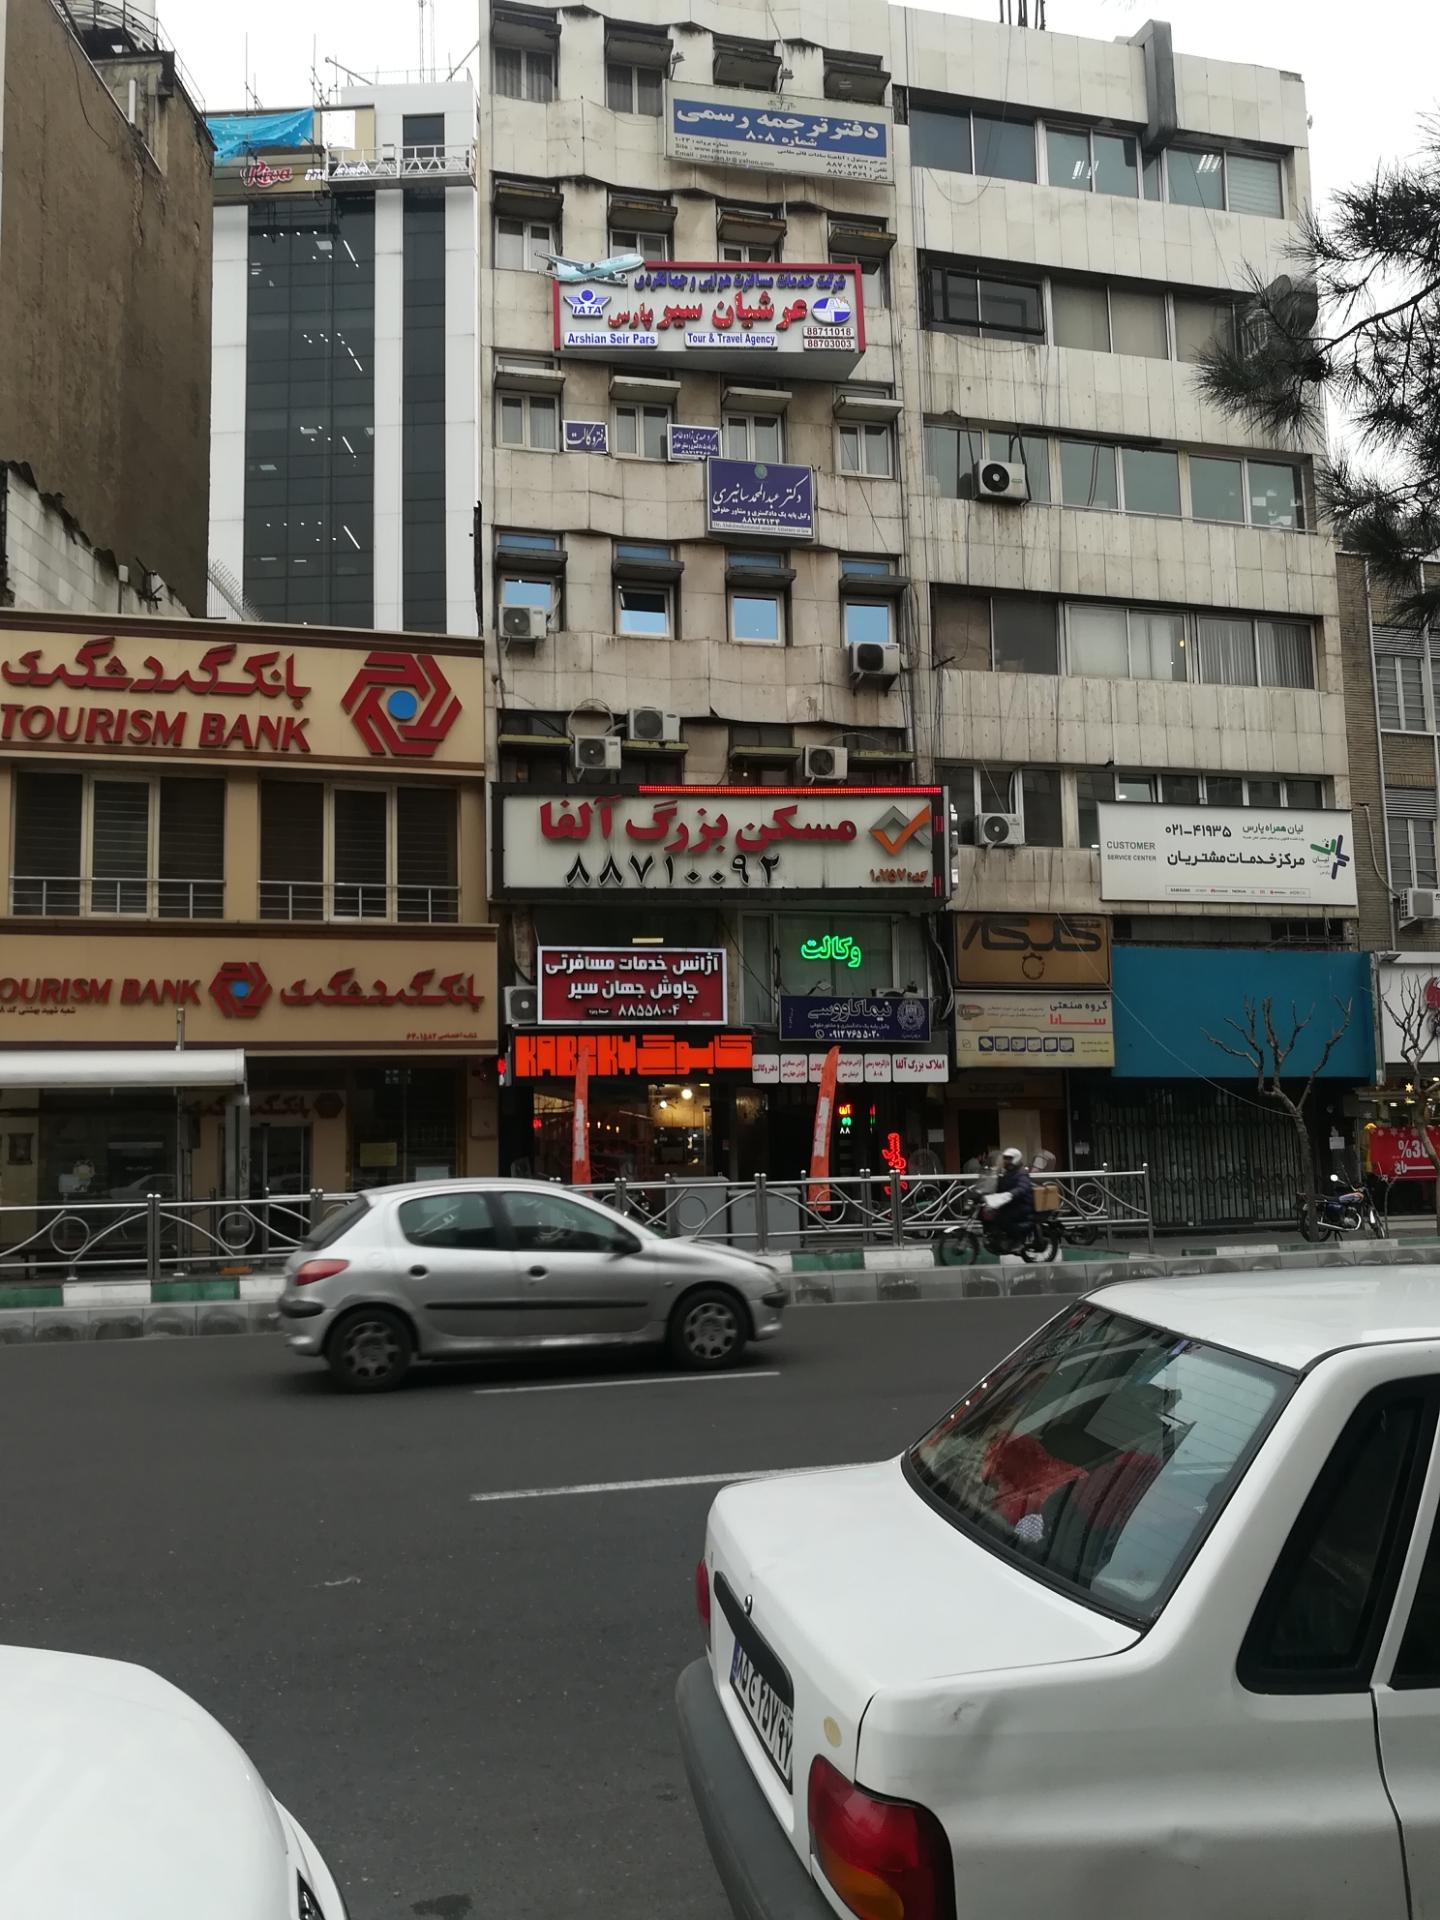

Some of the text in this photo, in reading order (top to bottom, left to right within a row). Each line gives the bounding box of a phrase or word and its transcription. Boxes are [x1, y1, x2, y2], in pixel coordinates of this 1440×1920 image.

[677, 108, 879, 140] دفتر ترجمه رسمی
[745, 129, 817, 147] شماره ۸۰۸
[634, 271, 847, 294] شرکت خدمات مسافرت هوایی و جهانگردی
[572, 305, 603, 316] IATA
[607, 290, 807, 331] عرشیان سیر پارس
[568, 332, 656, 345] Arshian Seir Pars
[687, 333, 776, 346] Tour & Travel Agency
[806, 327, 852, 337] 88711018
[807, 338, 852, 348] 88703003
[779, 474, 809, 508] دکتر
[0, 703, 311, 752] TOURISM BANK
[539, 795, 857, 853] مسکن بزرگ آلفا
[1242, 823, 1304, 835] لیان همراه پارس
[1106, 840, 1156, 850] CUSTOMER
[1167, 850, 1306, 868] مرکز خدمات مشتریان
[565, 854, 780, 887] ۸۸۷۱۰۰۹۲
[801, 934, 862, 968] وکالت
[545, 951, 720, 975] آژانس خدمات مسافرتی
[0, 978, 202, 1006] OURISM BANK
[568, 975, 699, 1004] چاوش جهان سیر
[618, 1003, 680, 1017] ۸۸۵۵۸۰۰۴
[808, 998, 866, 1022] کاووسی
[862, 998, 892, 1022] نیما
[1050, 1001, 1083, 1011] صنعتی
[1085, 1000, 1108, 1012] گروه
[896, 1057, 945, 1072] املاک بزرگ آلفا
